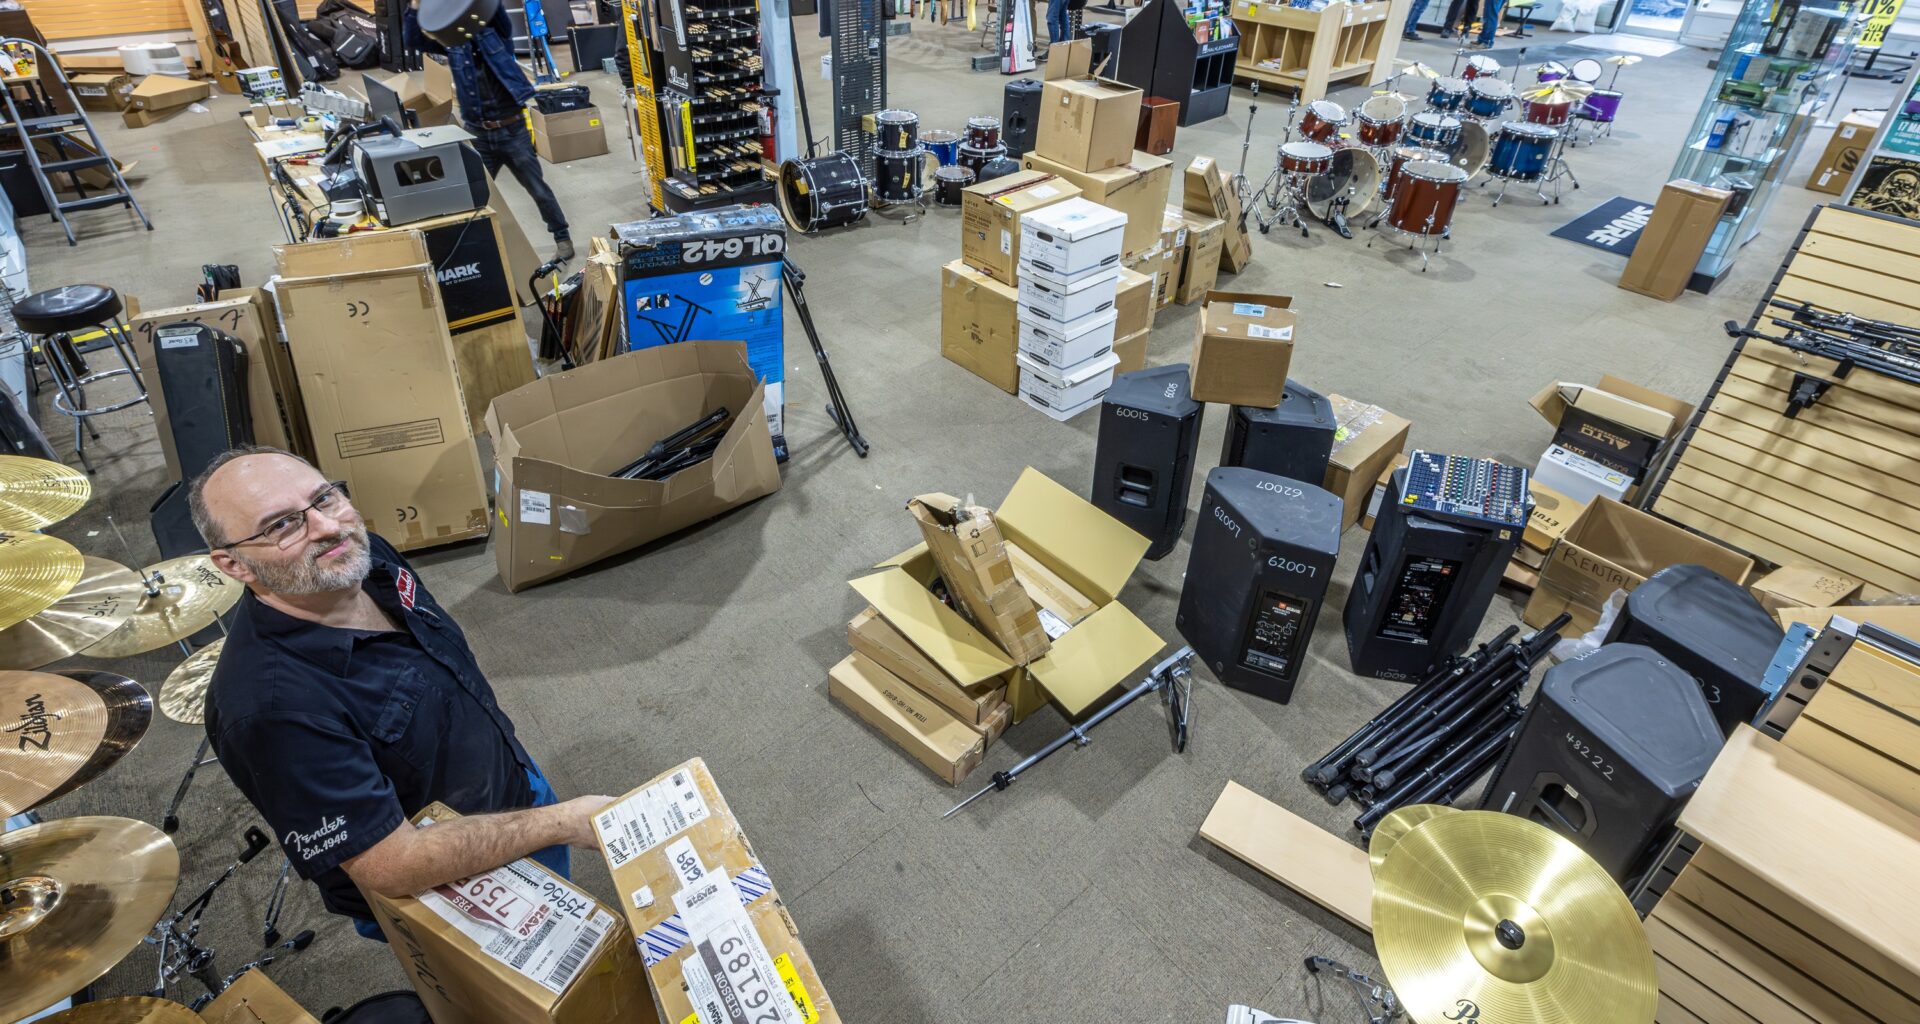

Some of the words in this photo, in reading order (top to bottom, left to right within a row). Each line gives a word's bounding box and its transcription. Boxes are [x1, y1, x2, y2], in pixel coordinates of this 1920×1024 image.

[1585, 205, 1653, 247] SHURE
[682, 233, 784, 264] QL642
[1116, 407, 1149, 421] 60015
[1562, 442, 1587, 456] ALTO
[1579, 425, 1630, 450] ALTO
[1256, 481, 1303, 498] 62007
[1214, 506, 1241, 538] 62007
[1268, 556, 1317, 578] 62007
[6, 693, 62, 752] Zildjian
[1566, 732, 1616, 781] 48222
[285, 816, 347, 853] Fender
[606, 839, 631, 865] Gibson
[452, 894, 474, 912] PRS
[543, 881, 588, 920] 75956
[714, 971, 742, 1019] GIBSON
[720, 937, 781, 1024] 26189
